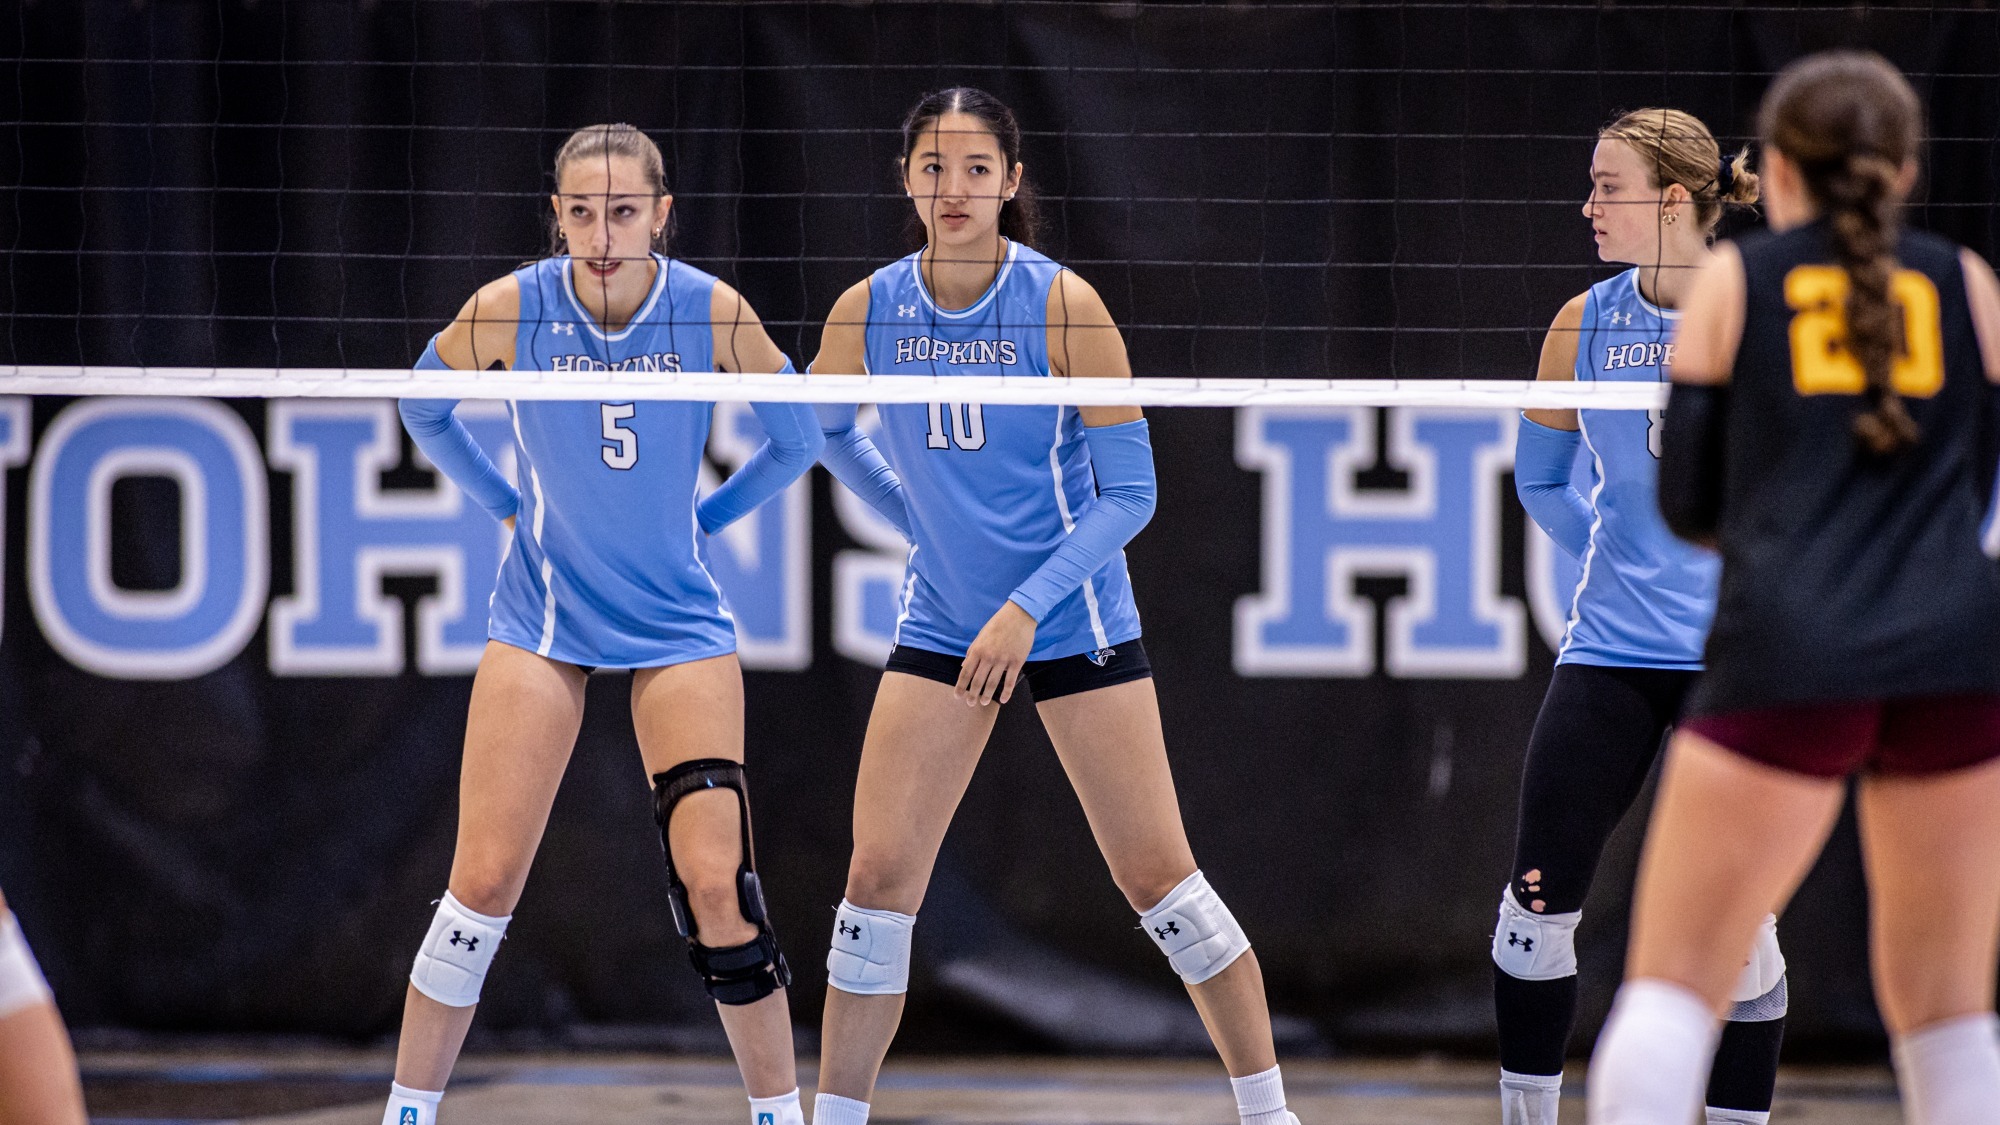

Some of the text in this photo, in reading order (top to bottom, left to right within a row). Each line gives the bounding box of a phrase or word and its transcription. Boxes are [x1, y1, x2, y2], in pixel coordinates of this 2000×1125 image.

[895, 335, 1018, 366] HOPKINS
[1783, 263, 1945, 399] 20
[600, 401, 639, 471] 5
[926, 402, 987, 451] 10
